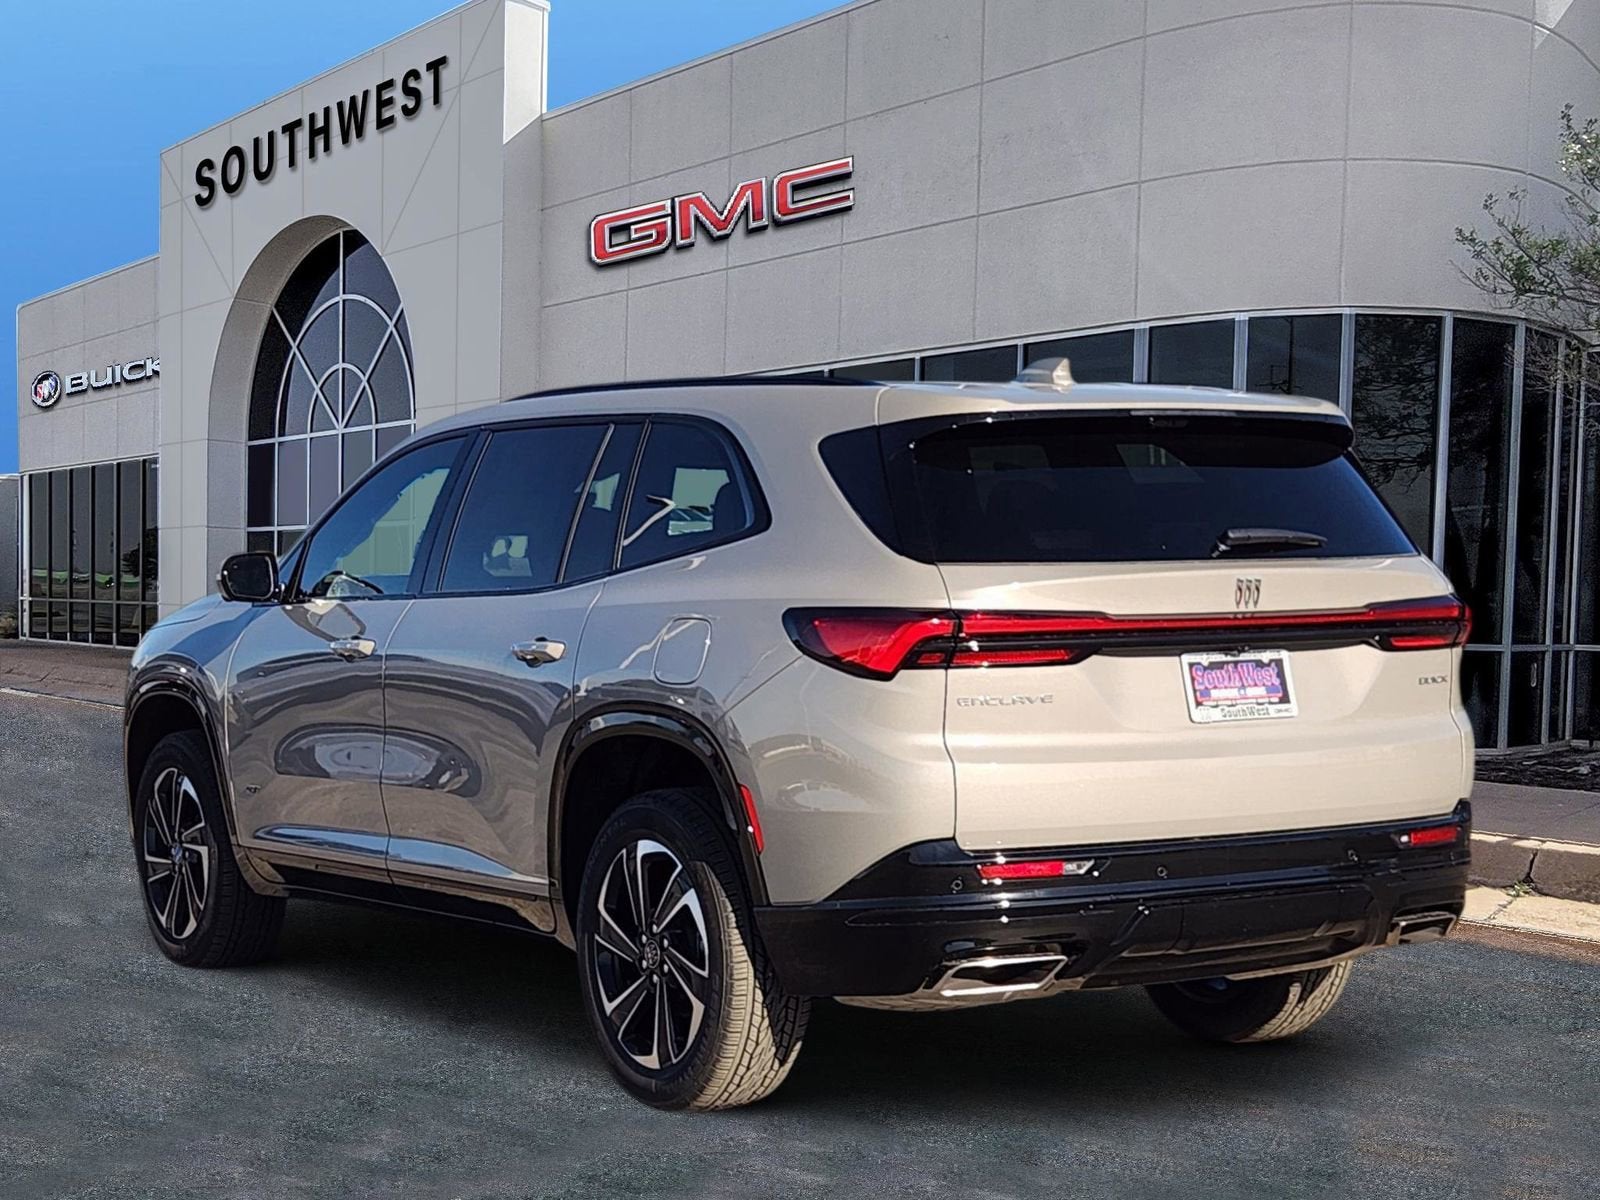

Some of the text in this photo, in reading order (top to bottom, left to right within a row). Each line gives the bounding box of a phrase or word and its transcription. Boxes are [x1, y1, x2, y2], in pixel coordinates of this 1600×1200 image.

[195, 56, 447, 207] SOUTHWEST
[590, 155, 855, 265] GMC
[65, 357, 160, 394] BUICK
[1192, 662, 1280, 690] SouthWest
[956, 694, 1054, 707] ENCLAVE
